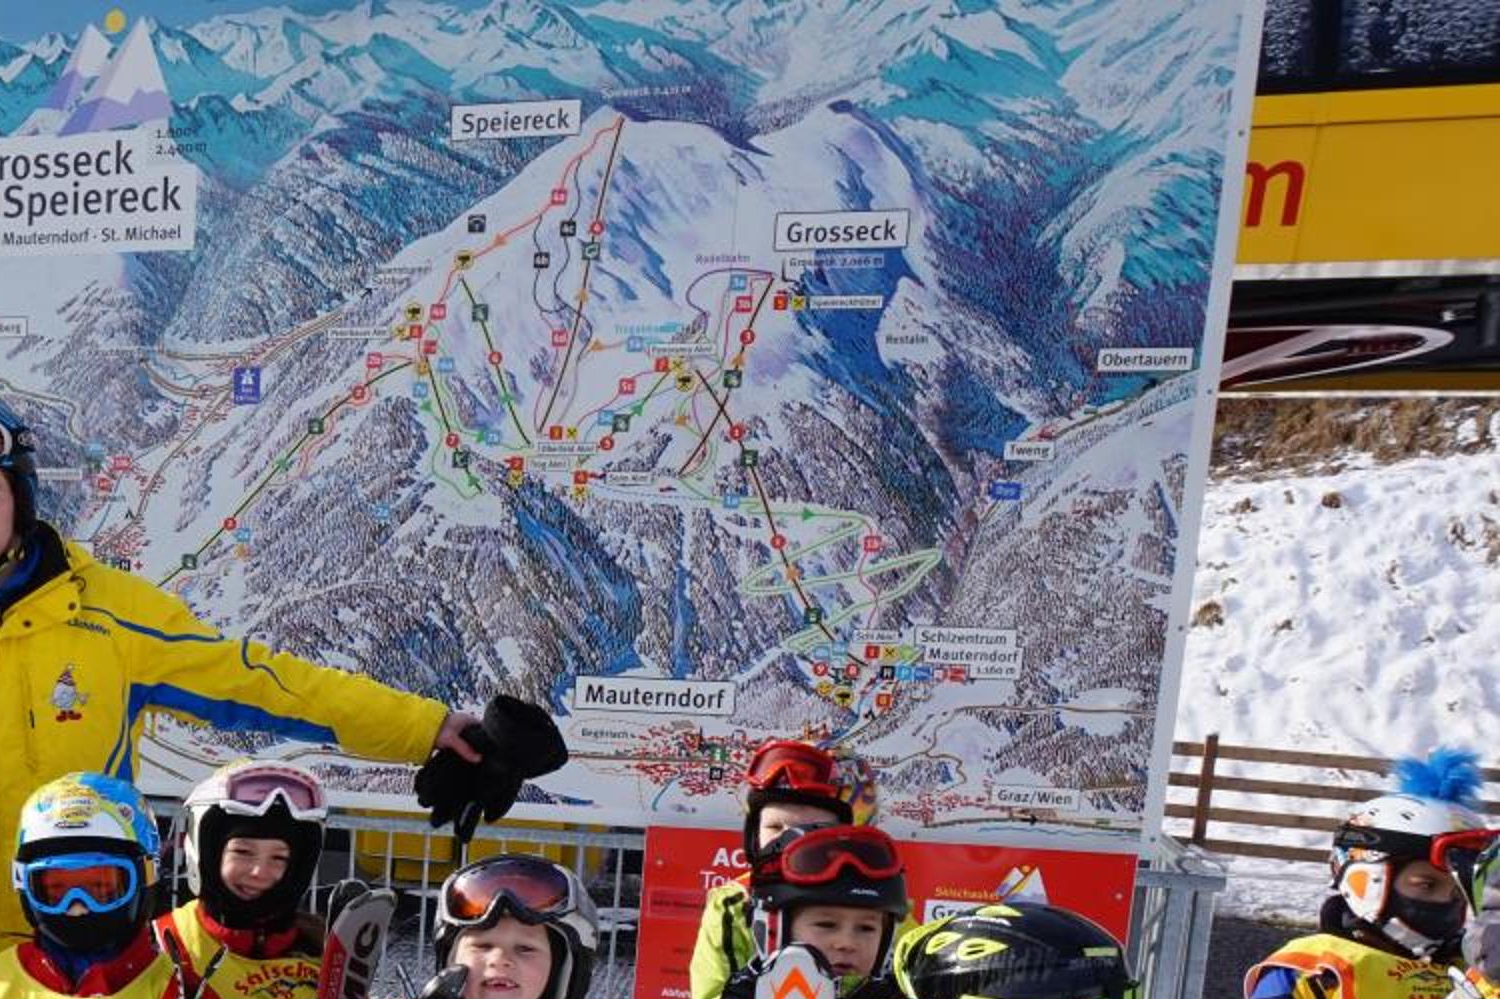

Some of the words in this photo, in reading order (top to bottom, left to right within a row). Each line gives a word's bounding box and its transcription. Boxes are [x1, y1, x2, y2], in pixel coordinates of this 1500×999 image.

[461, 107, 571, 141] Speiereck
[3, 175, 182, 227] Speiereck
[2, 229, 90, 246] Mauterndorf
[101, 227, 121, 243] St.
[125, 224, 182, 241] Michael
[786, 219, 897, 243] Grosseck
[1102, 351, 1188, 367] Obertauern
[921, 630, 1007, 646] Schizentrum
[928, 649, 1019, 663] Mauterndorf
[585, 683, 726, 709] Mauterndorf
[997, 789, 1073, 806] Graz/Wien
